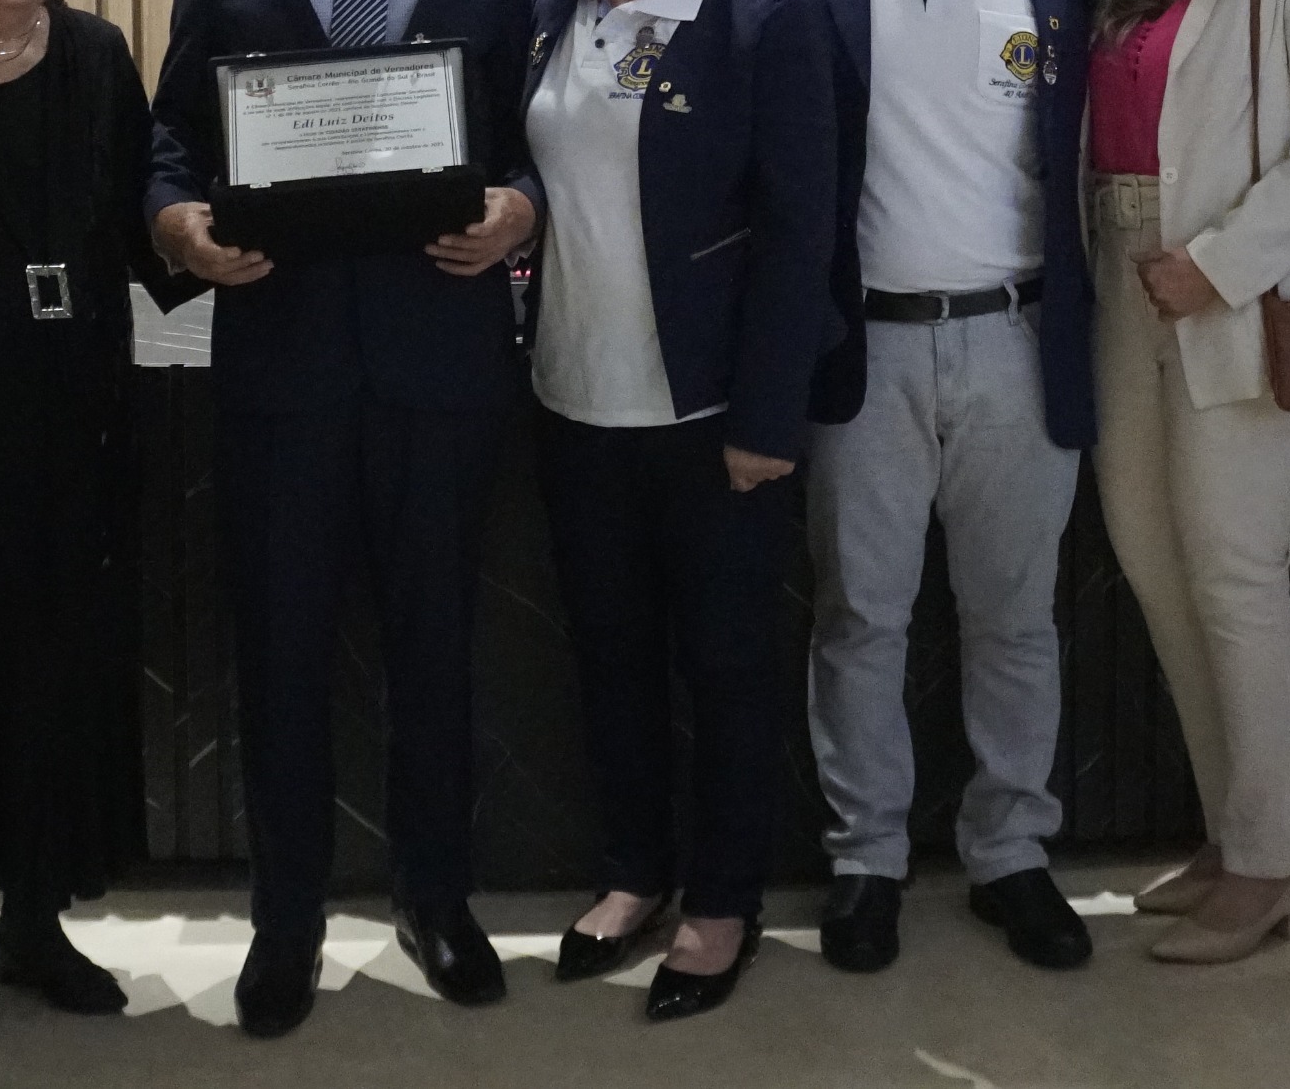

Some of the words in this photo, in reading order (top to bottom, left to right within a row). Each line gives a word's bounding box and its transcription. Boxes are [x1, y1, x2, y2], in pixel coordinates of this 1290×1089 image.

[1019, 46, 1030, 64] L
[287, 74, 322, 83] Câmara
[325, 68, 368, 80] Municipal
[370, 67, 381, 75] de
[384, 62, 434, 74] Vereadores
[293, 118, 315, 129] Edi
[319, 116, 347, 127] Luiz
[352, 112, 395, 124] Deitos
